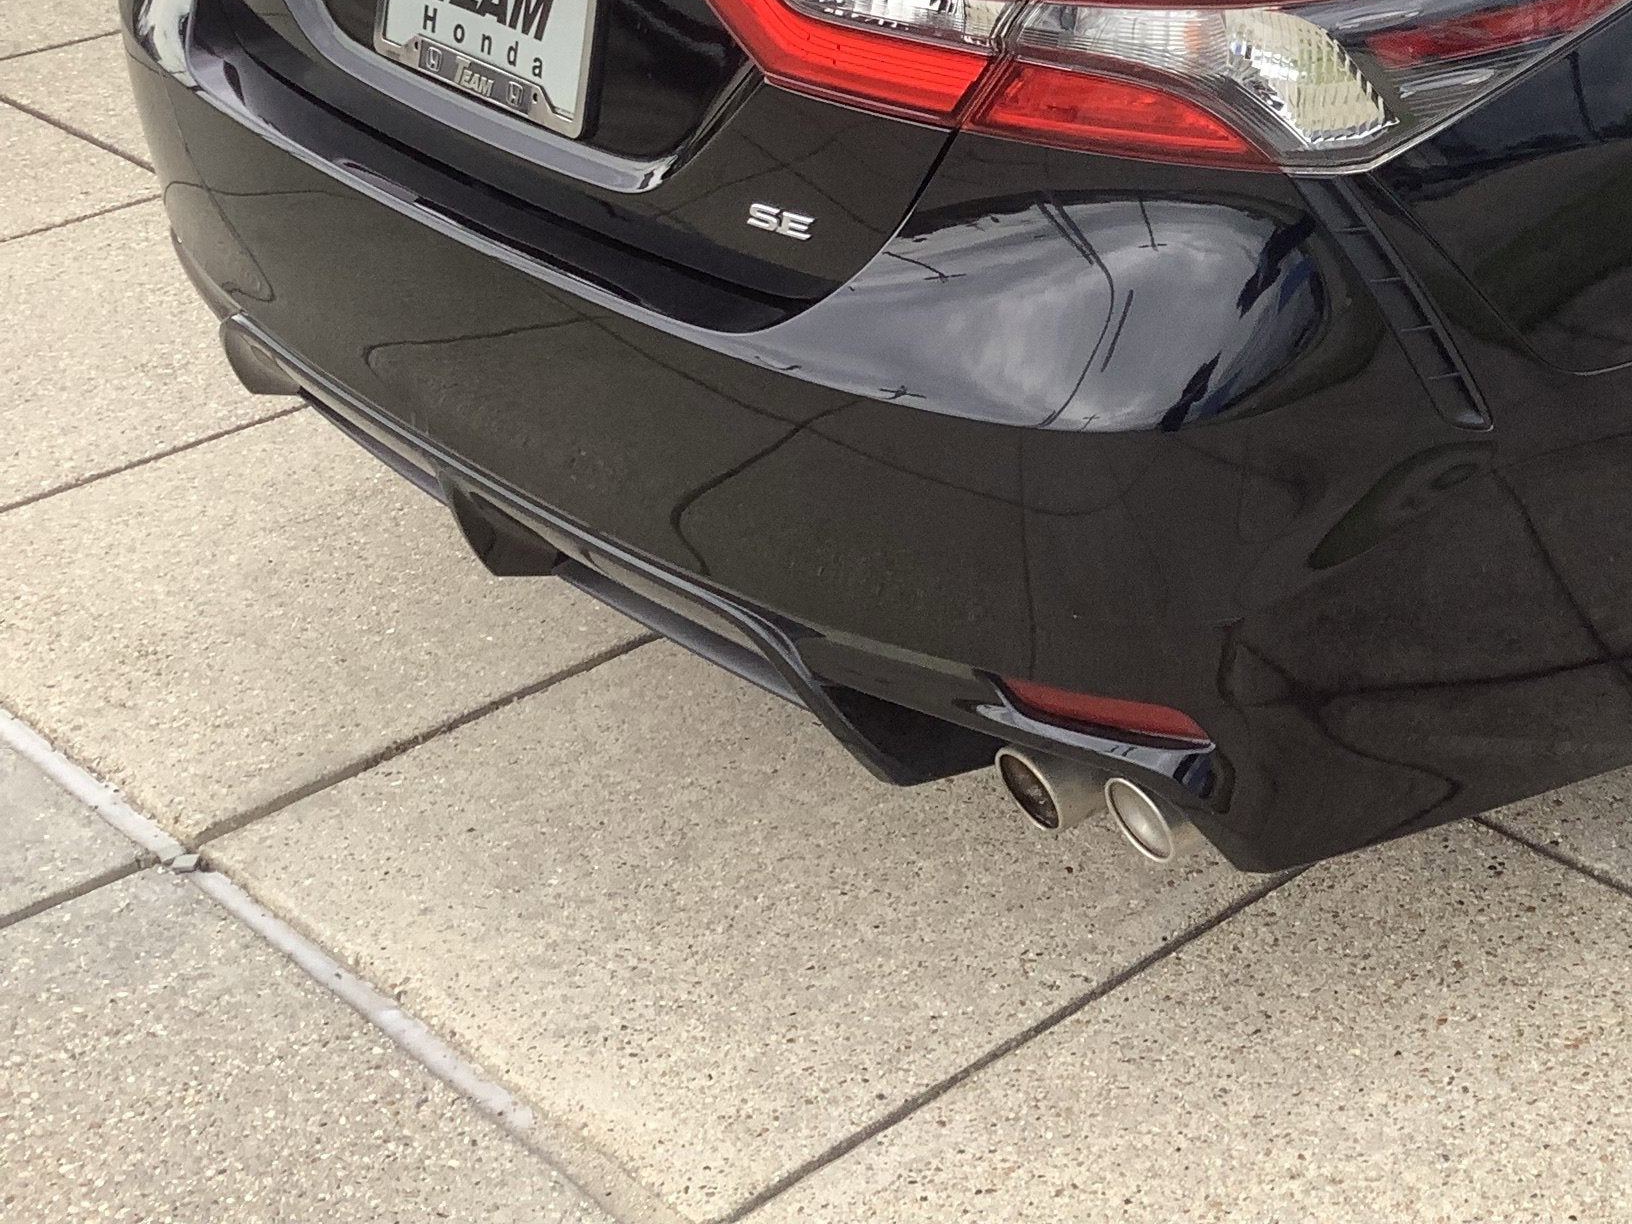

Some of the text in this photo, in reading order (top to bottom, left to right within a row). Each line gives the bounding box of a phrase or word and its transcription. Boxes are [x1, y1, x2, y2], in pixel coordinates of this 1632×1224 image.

[422, 4, 544, 78] Honda
[454, 55, 496, 98] TEAM
[746, 202, 817, 242] SE
